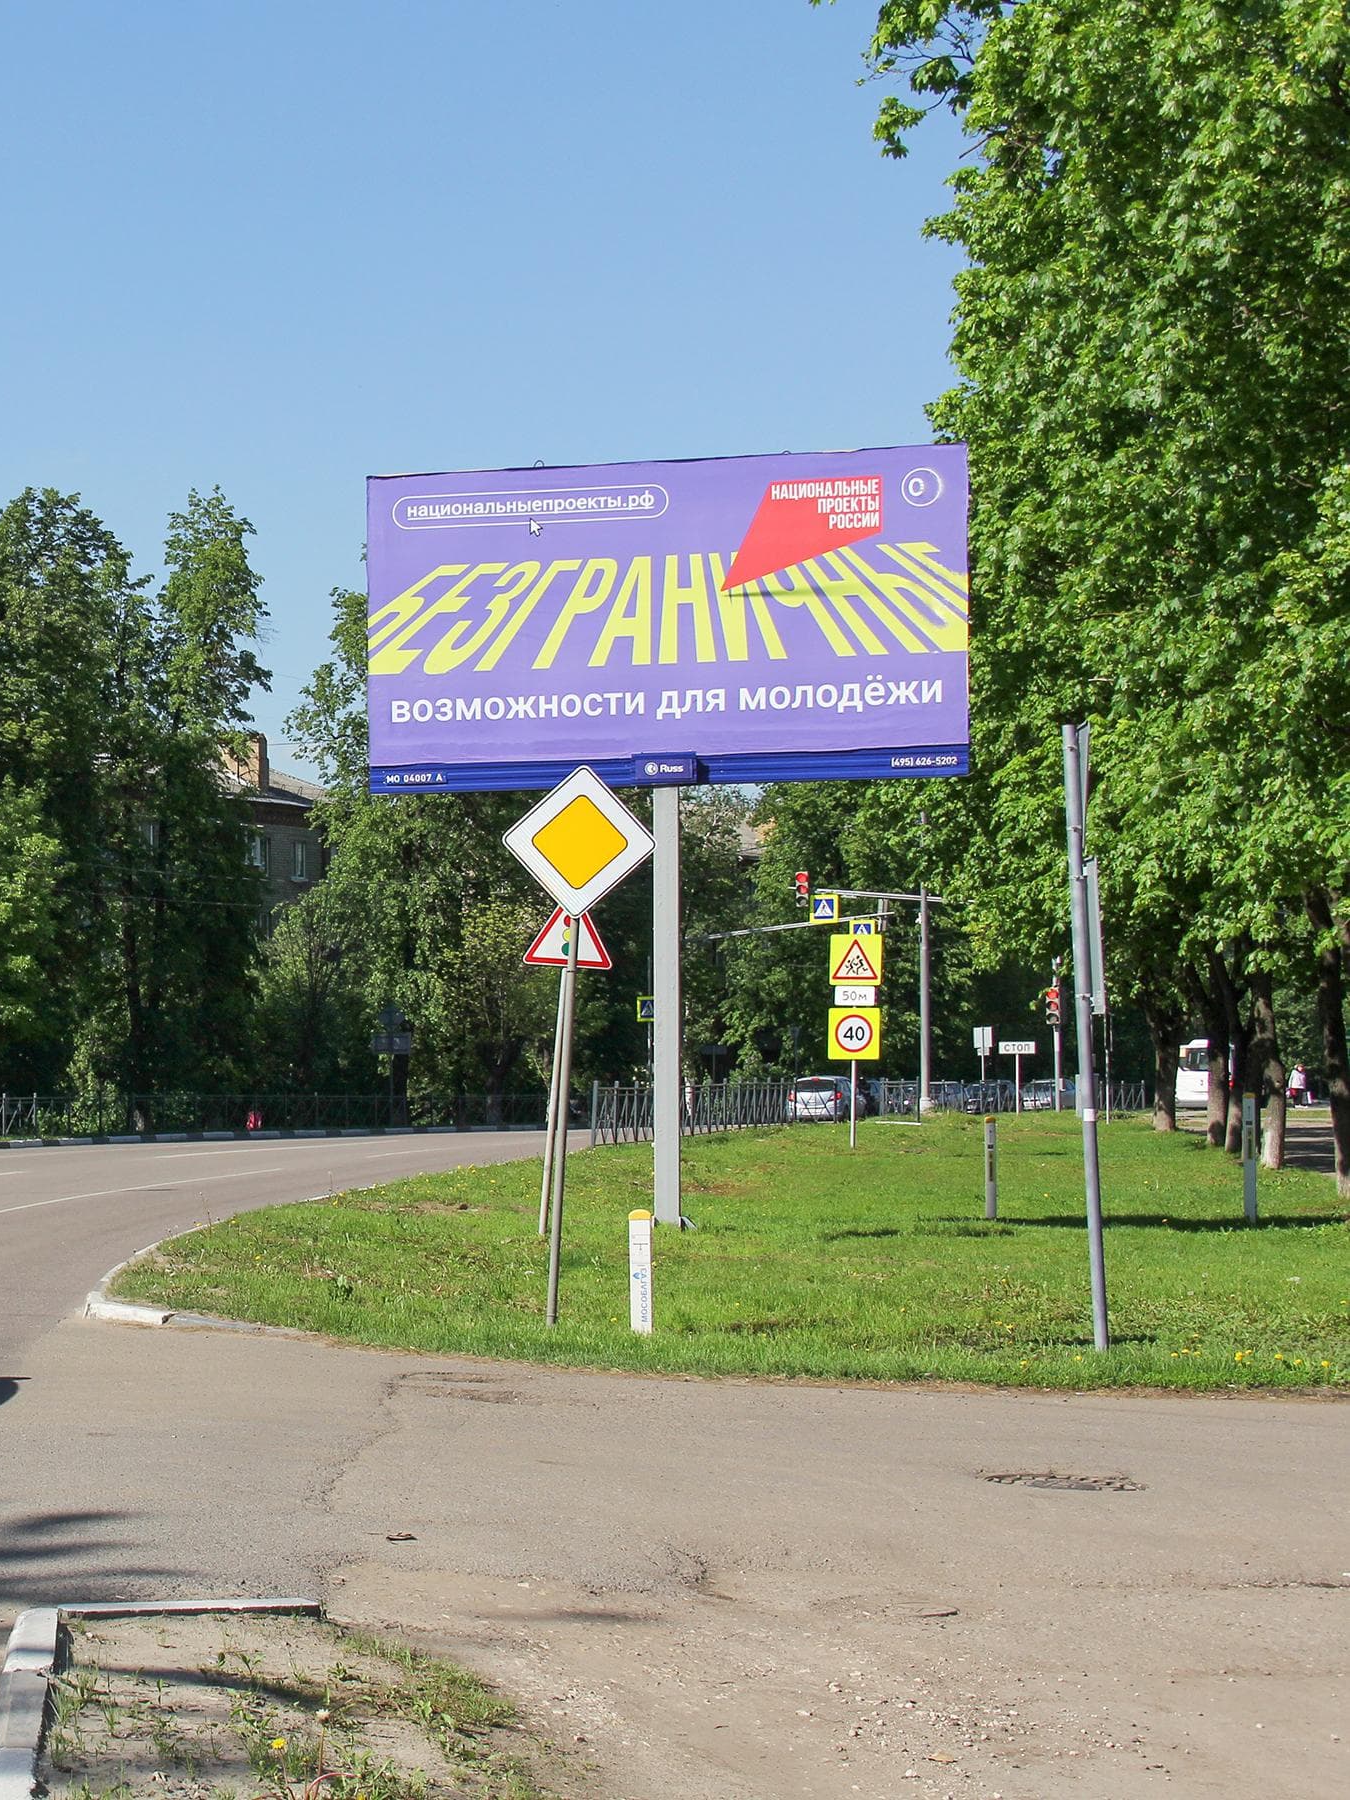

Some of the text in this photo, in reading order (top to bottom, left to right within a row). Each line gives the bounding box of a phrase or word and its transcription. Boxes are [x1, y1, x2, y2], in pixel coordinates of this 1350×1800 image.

[771, 479, 879, 500] НАЦИОНАЛЬНЫЕ
[407, 490, 655, 519] национальныепроекты.рф
[817, 496, 880, 513] ПРОЕКТЫ
[829, 512, 879, 529] РОССИИ
[391, 674, 942, 723] возможности для молодёжи
[660, 764, 684, 773] Russ
[891, 756, 957, 767] (495) 626-5202
[843, 1026, 865, 1041] 40
[1003, 1043, 1031, 1052] СТОП
